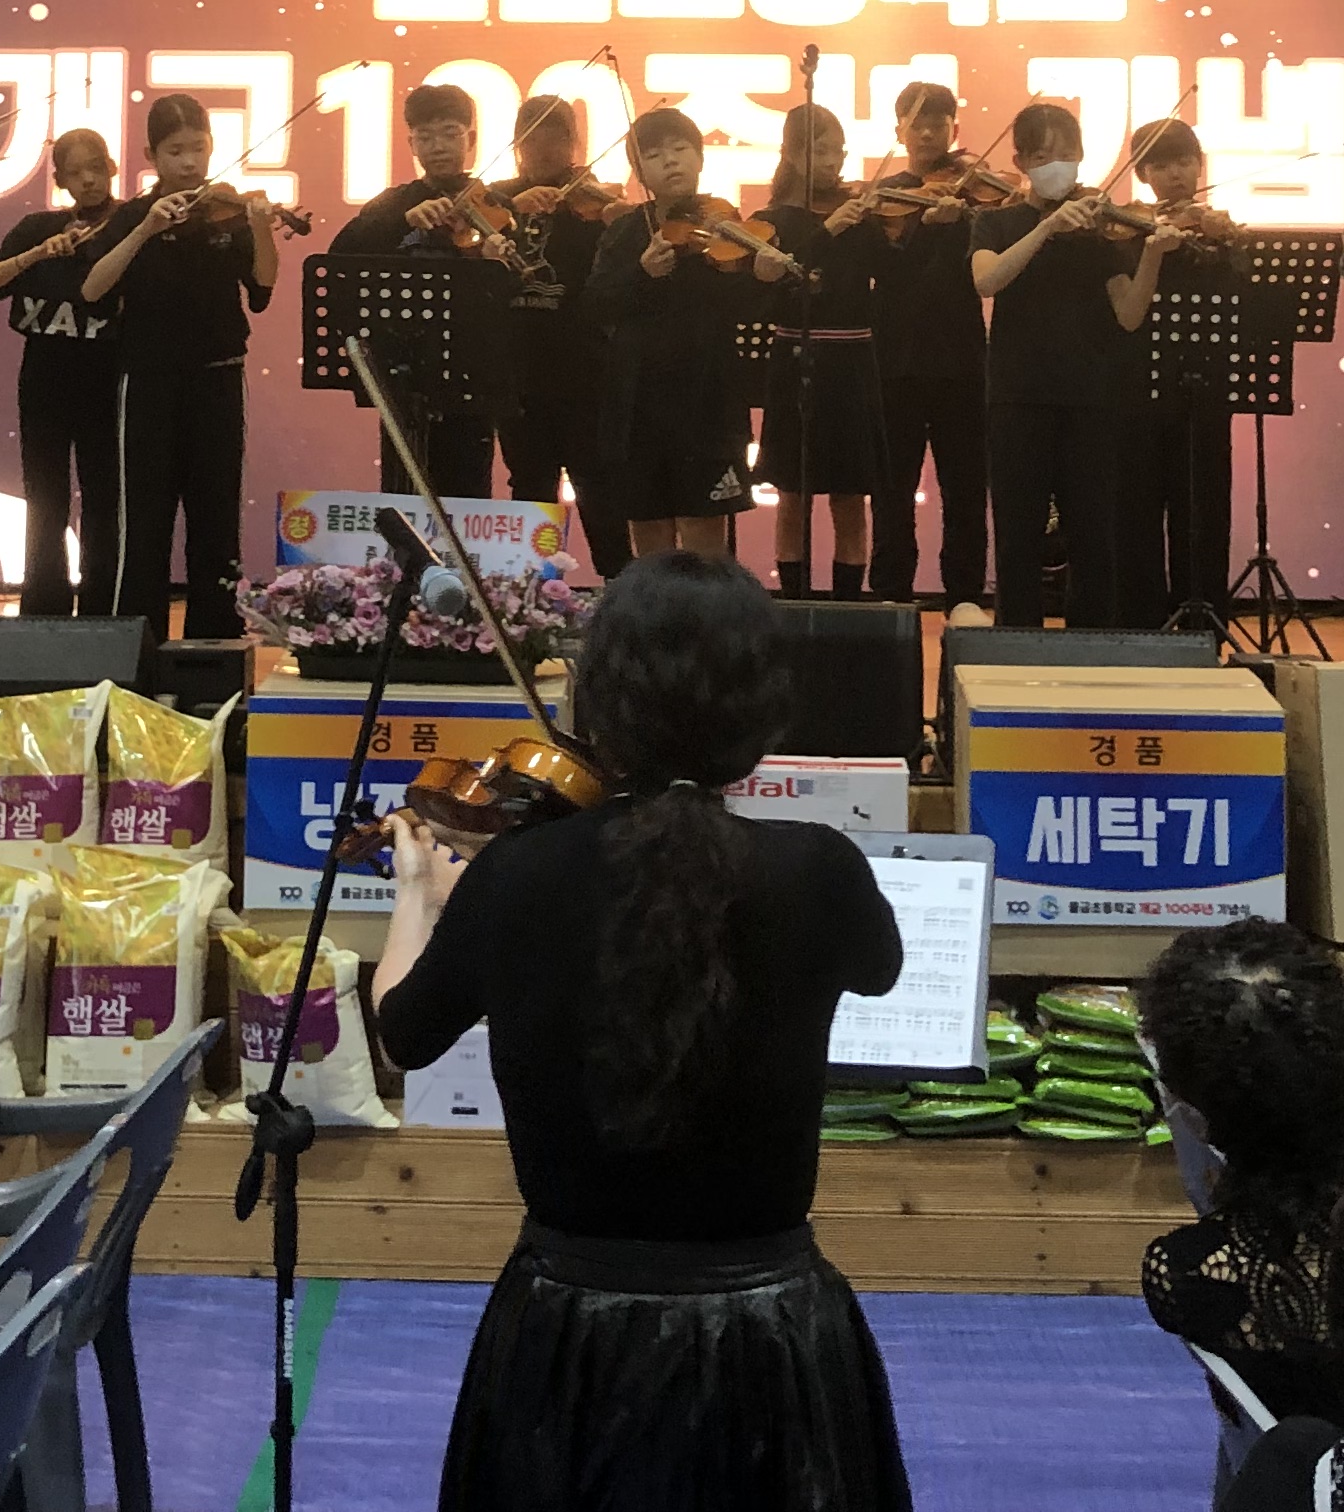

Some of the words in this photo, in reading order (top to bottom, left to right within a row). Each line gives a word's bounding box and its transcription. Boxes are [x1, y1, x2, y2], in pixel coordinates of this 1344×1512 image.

[464, 513, 524, 542] 100주년
[722, 777, 800, 799] efal
[110, 805, 173, 845] 햅쌀
[1027, 794, 1231, 869] 세탁기
[340, 887, 397, 901] 물금초등학
[61, 993, 134, 1036] 햅쌀
